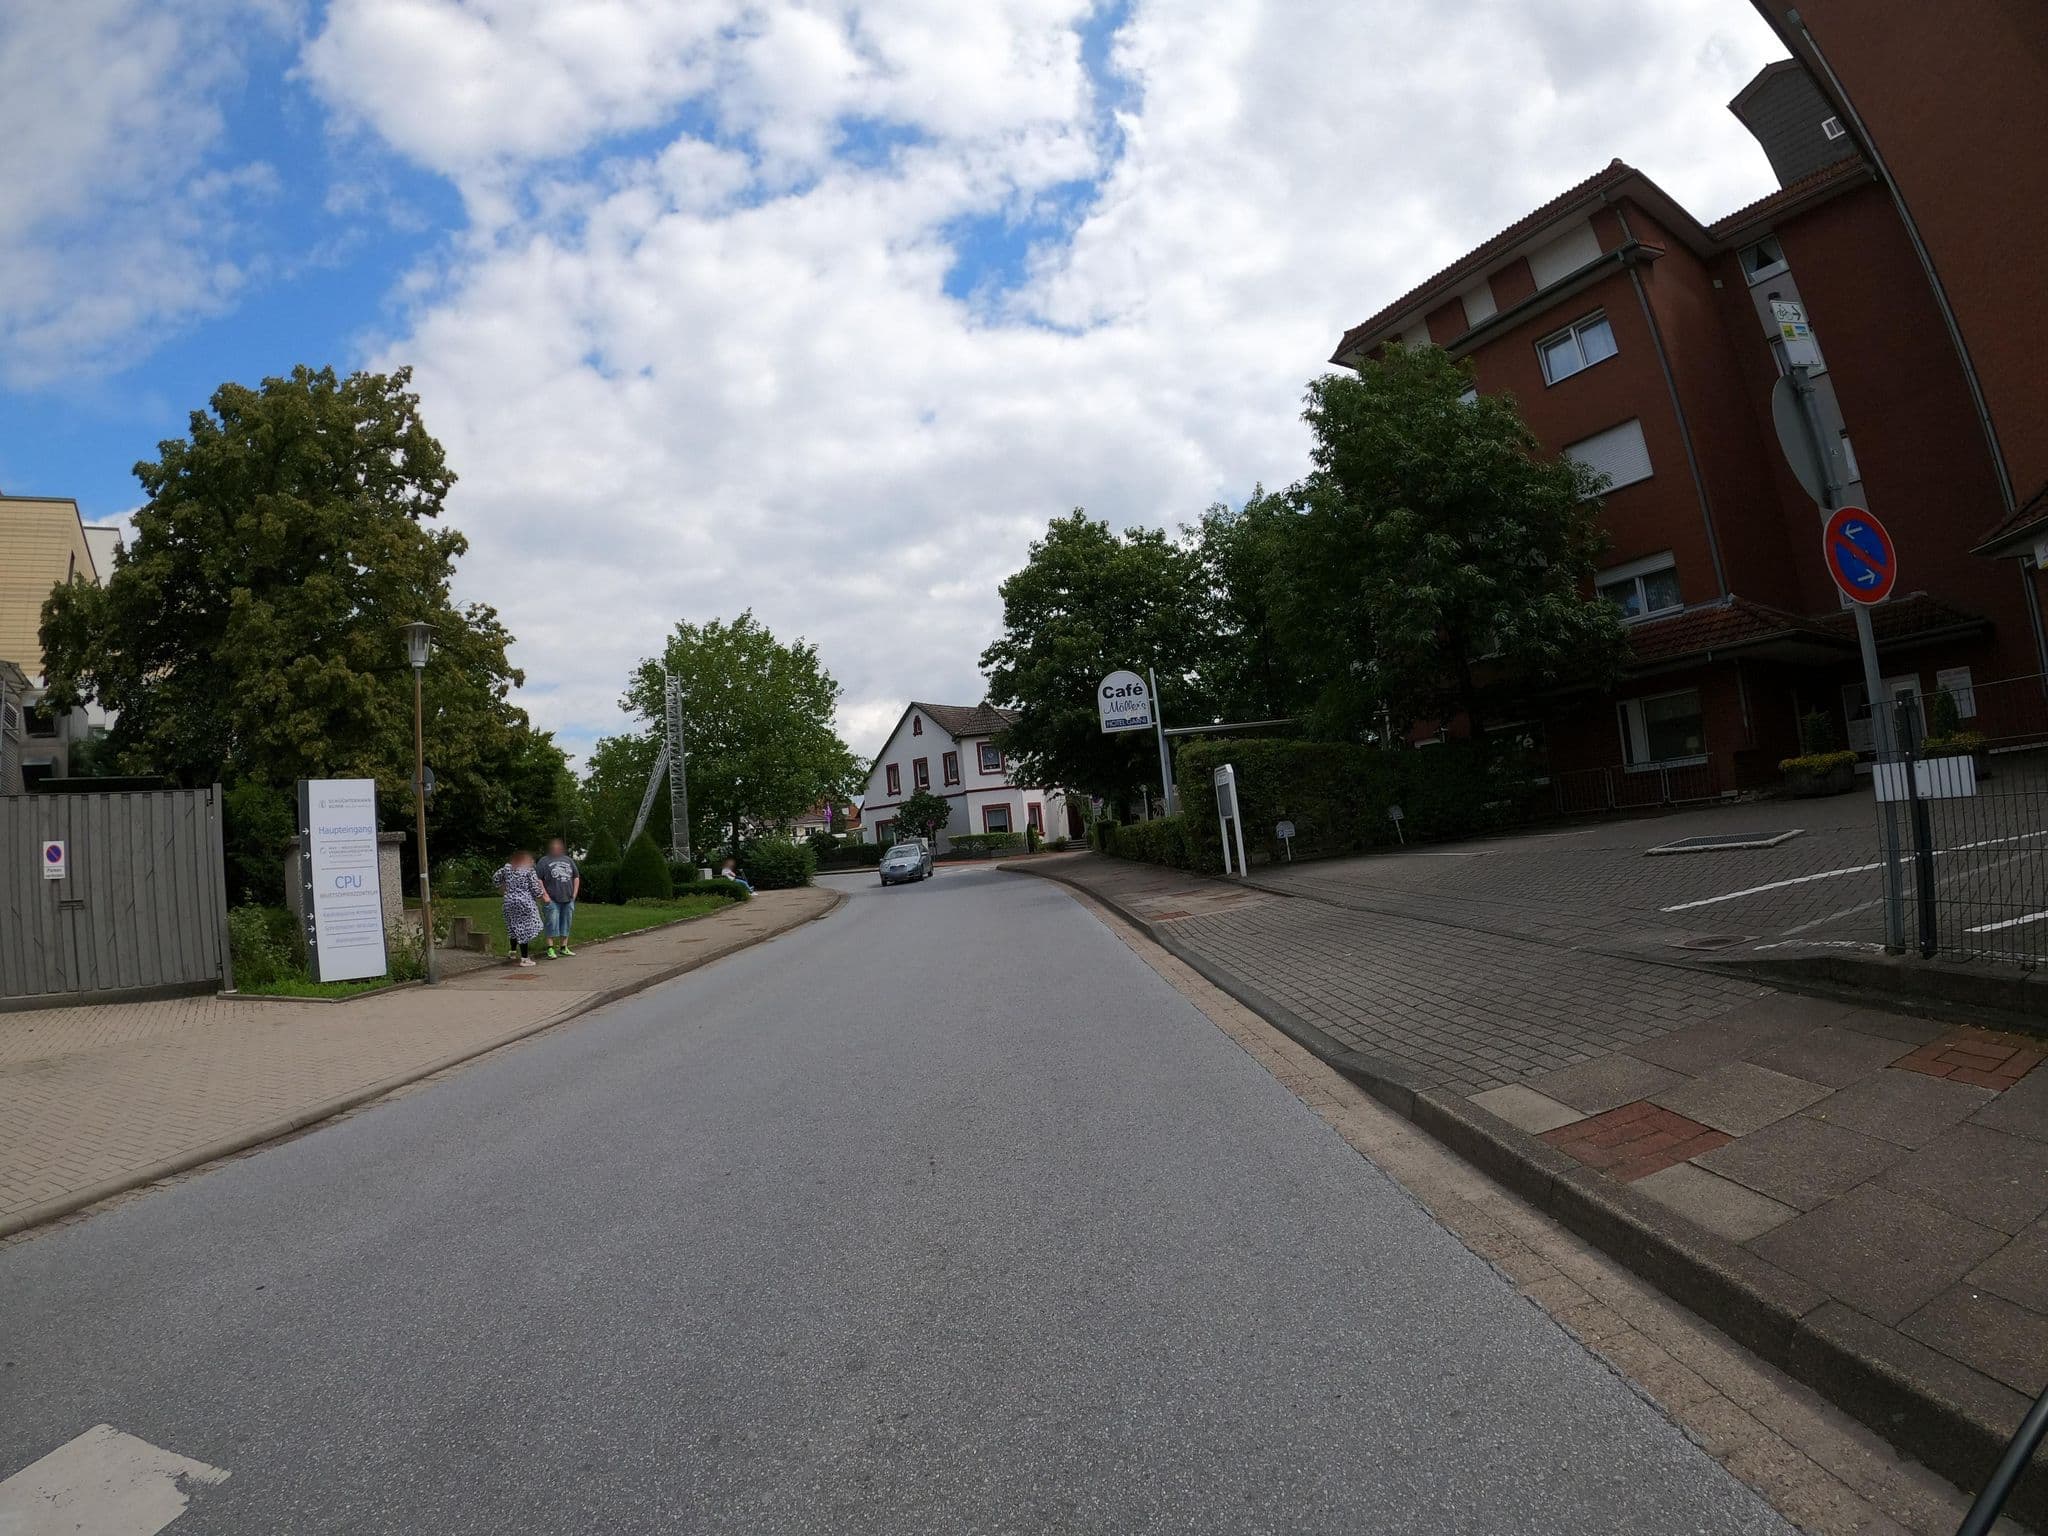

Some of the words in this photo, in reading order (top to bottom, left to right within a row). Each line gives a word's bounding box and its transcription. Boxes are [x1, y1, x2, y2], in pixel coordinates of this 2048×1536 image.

[1102, 683, 1143, 699] Café
[318, 825, 373, 835] Haupteingang
[335, 875, 362, 889] CPU
